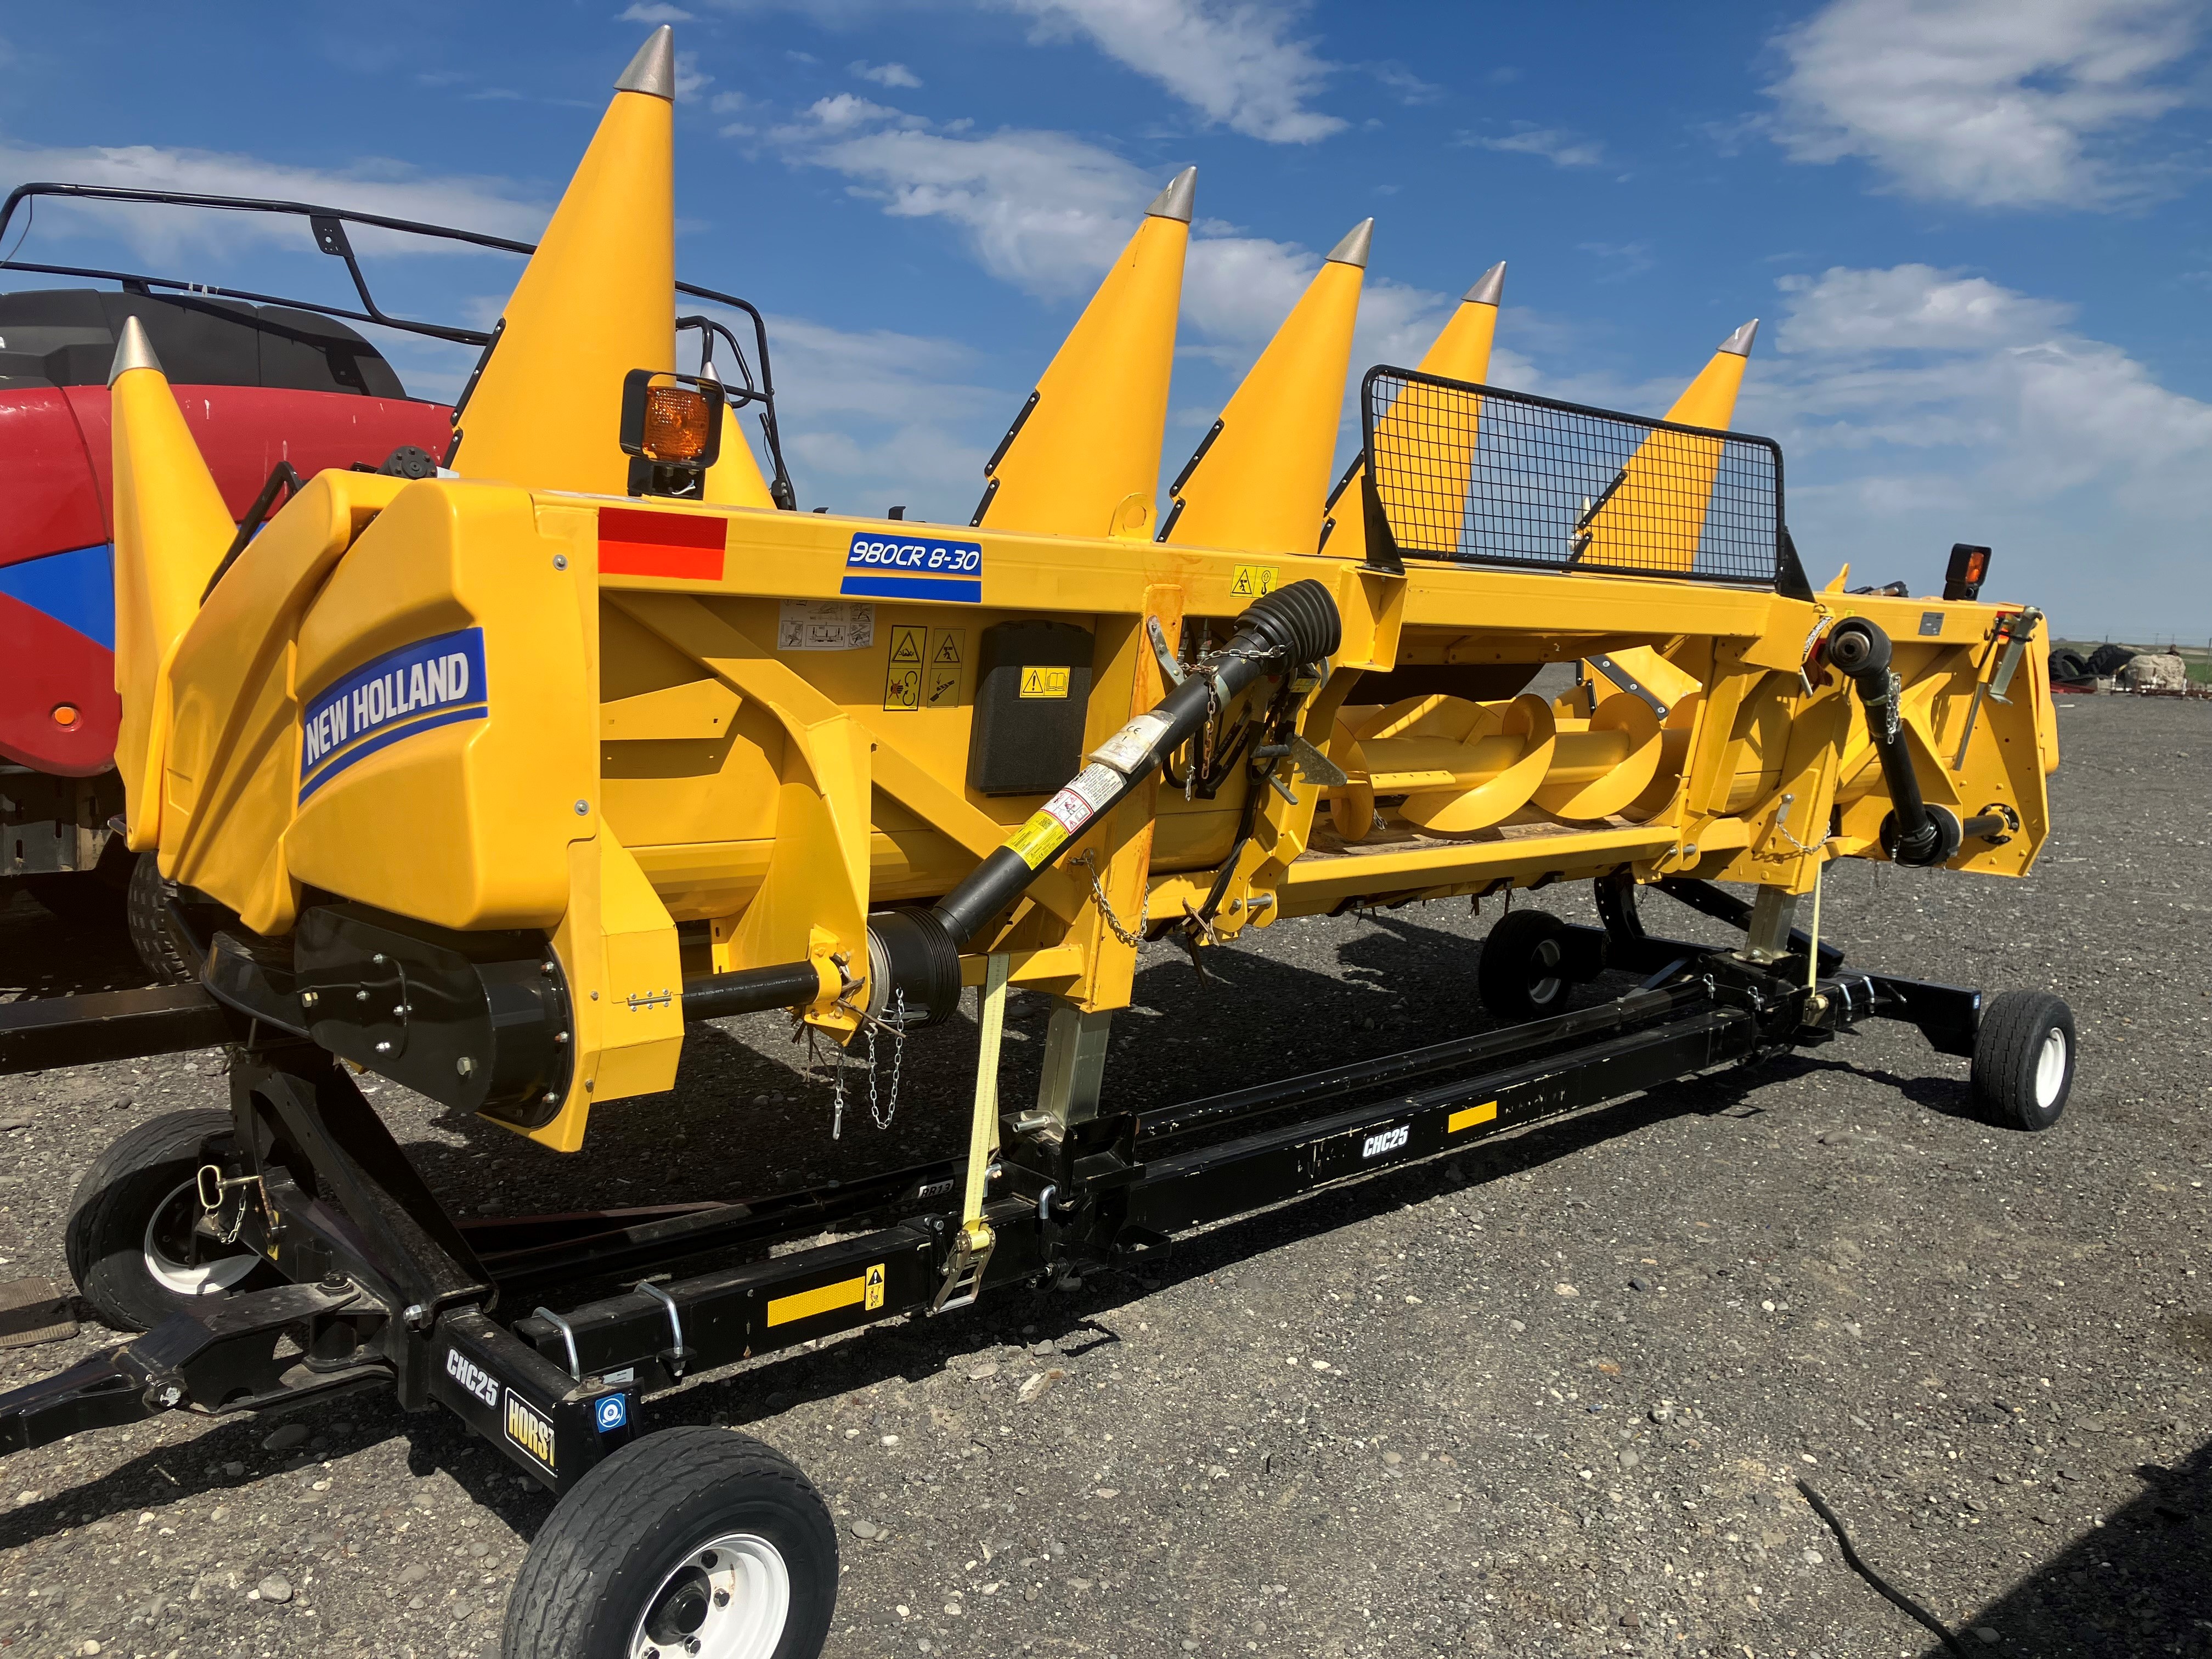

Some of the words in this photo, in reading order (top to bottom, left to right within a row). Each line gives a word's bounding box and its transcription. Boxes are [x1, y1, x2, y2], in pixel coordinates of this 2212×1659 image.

[850, 541, 926, 567] 980CR
[928, 548, 979, 571] 8-30
[306, 695, 348, 766] NEW
[353, 652, 469, 733] HOLLAND
[1364, 1125, 1409, 1158] CHC25
[447, 1348, 499, 1407] CHC25
